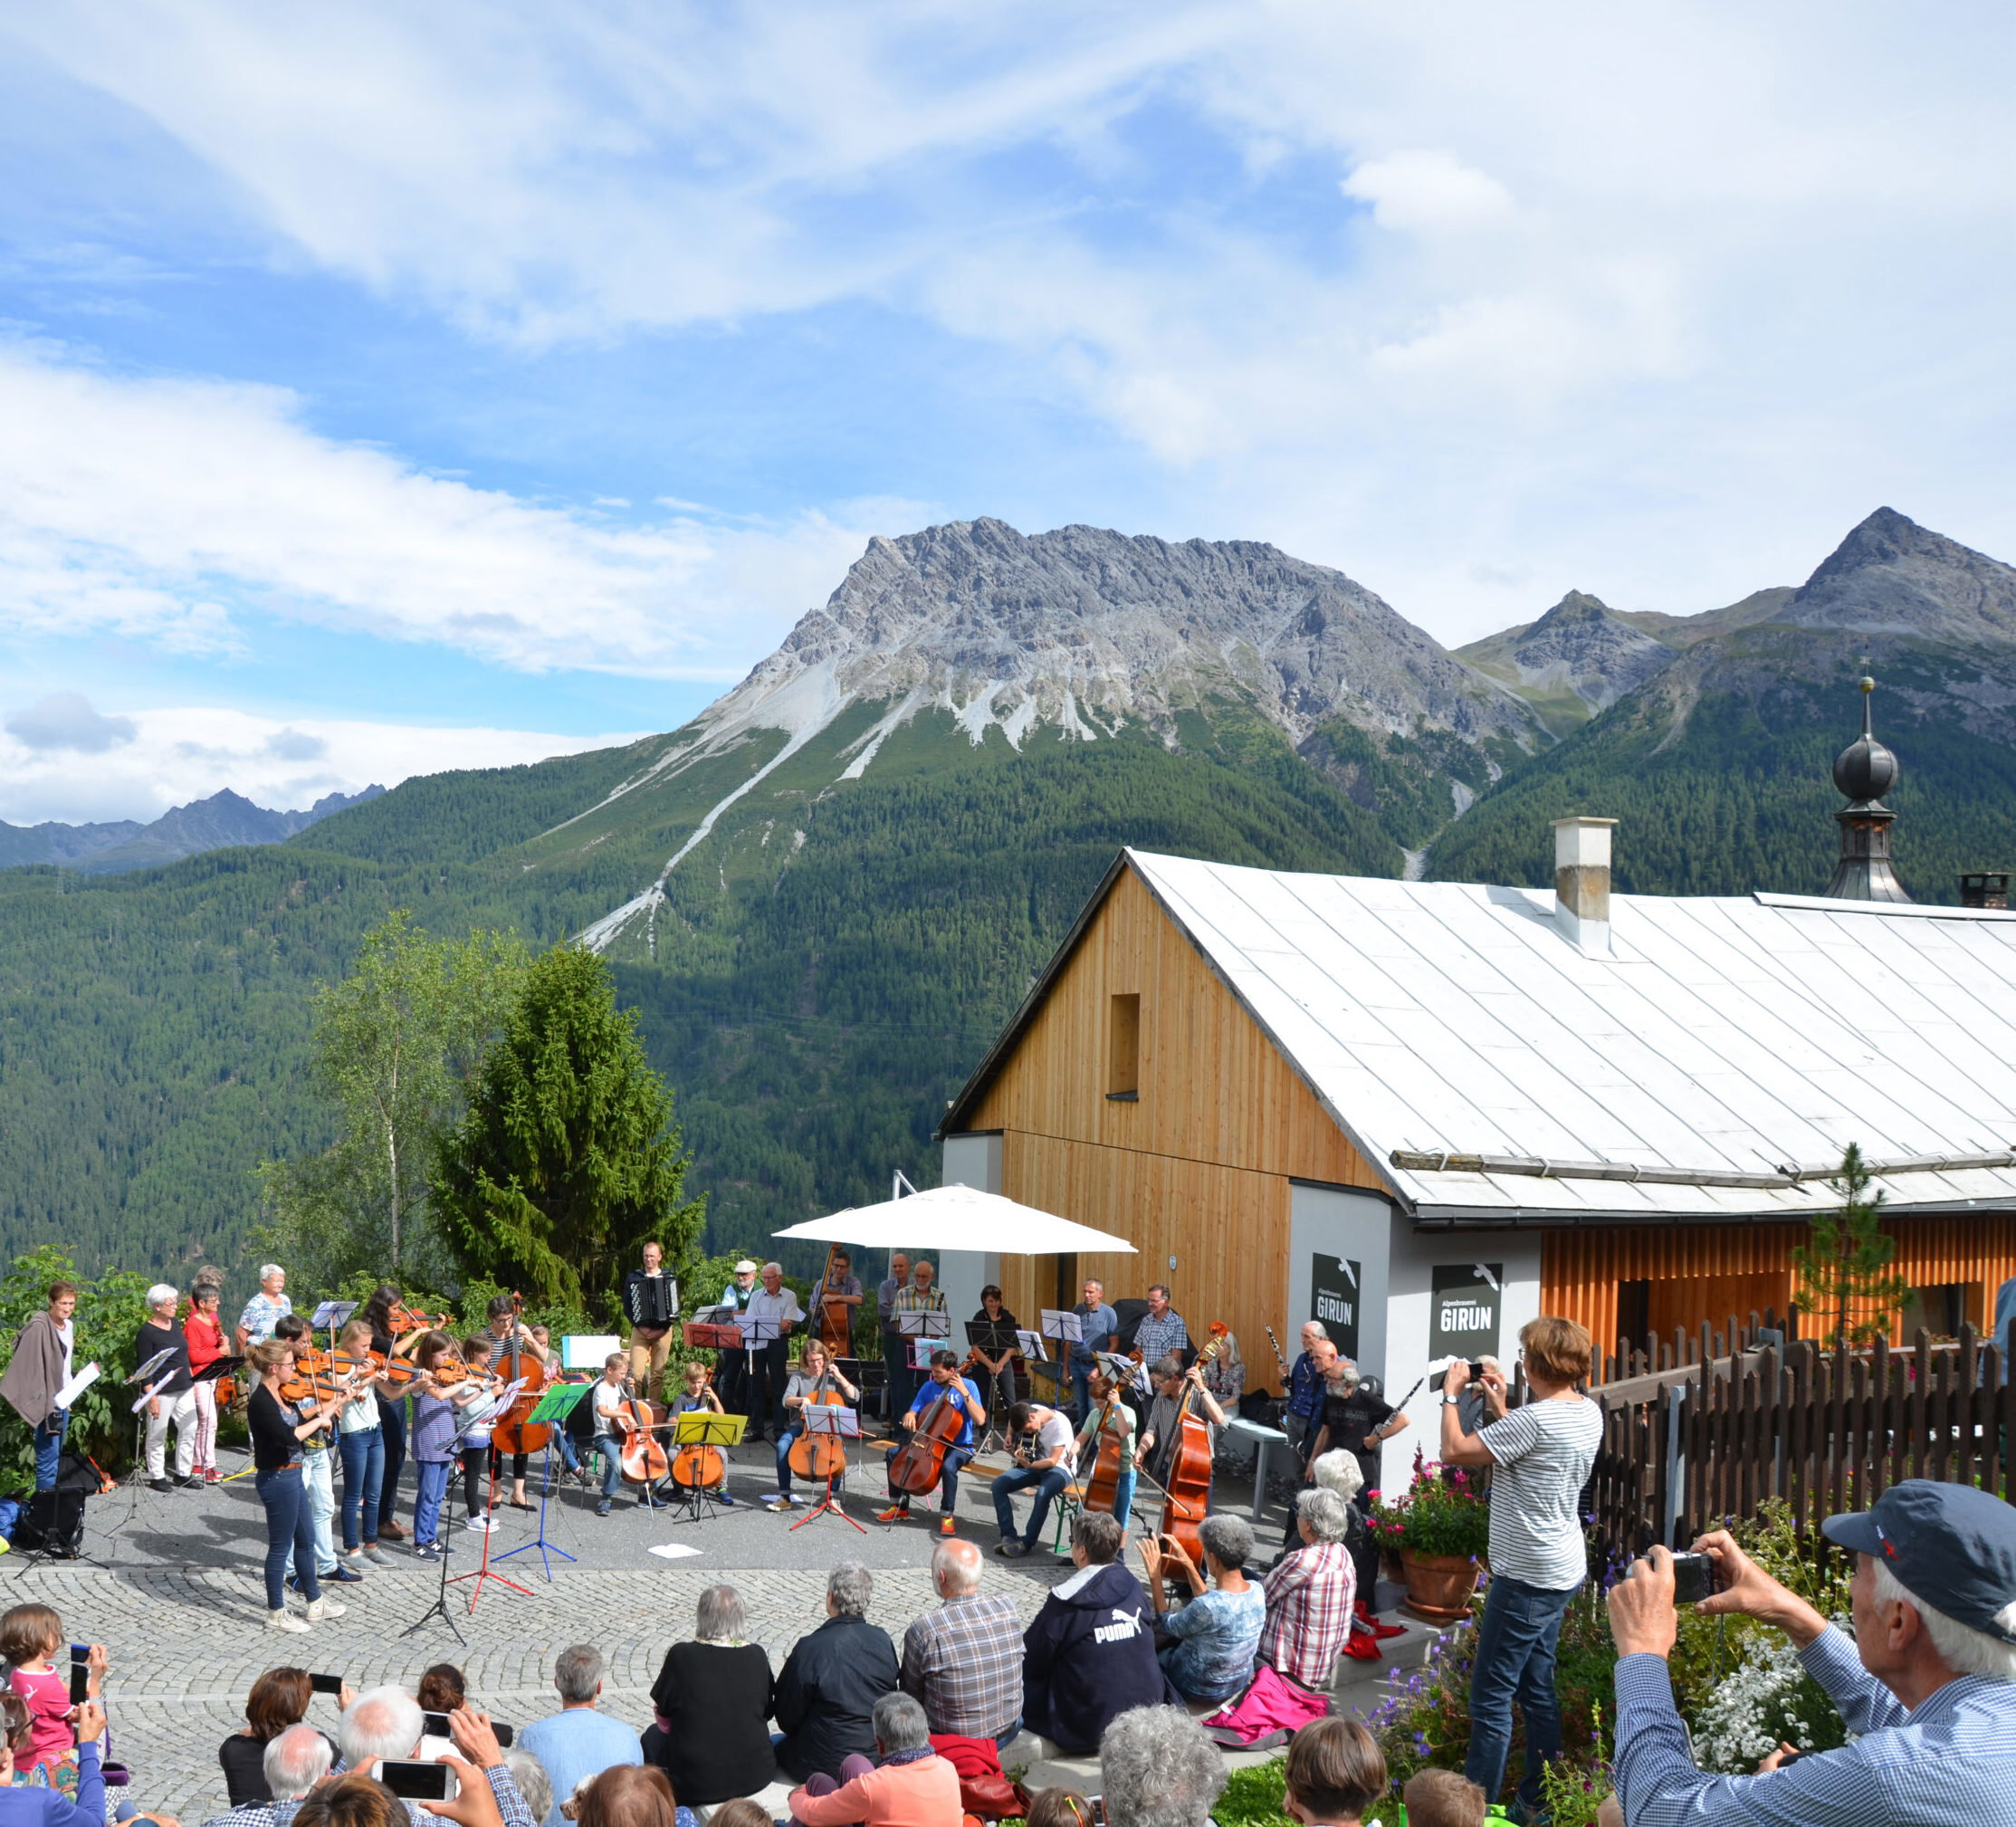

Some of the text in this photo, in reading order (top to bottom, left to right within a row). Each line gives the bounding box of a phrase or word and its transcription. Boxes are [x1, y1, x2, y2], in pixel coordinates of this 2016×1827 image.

[1317, 1296, 1352, 1326] GIRUN
[1440, 1306, 1492, 1332] GIRUN
[1094, 1621, 1135, 1644] PUMA
